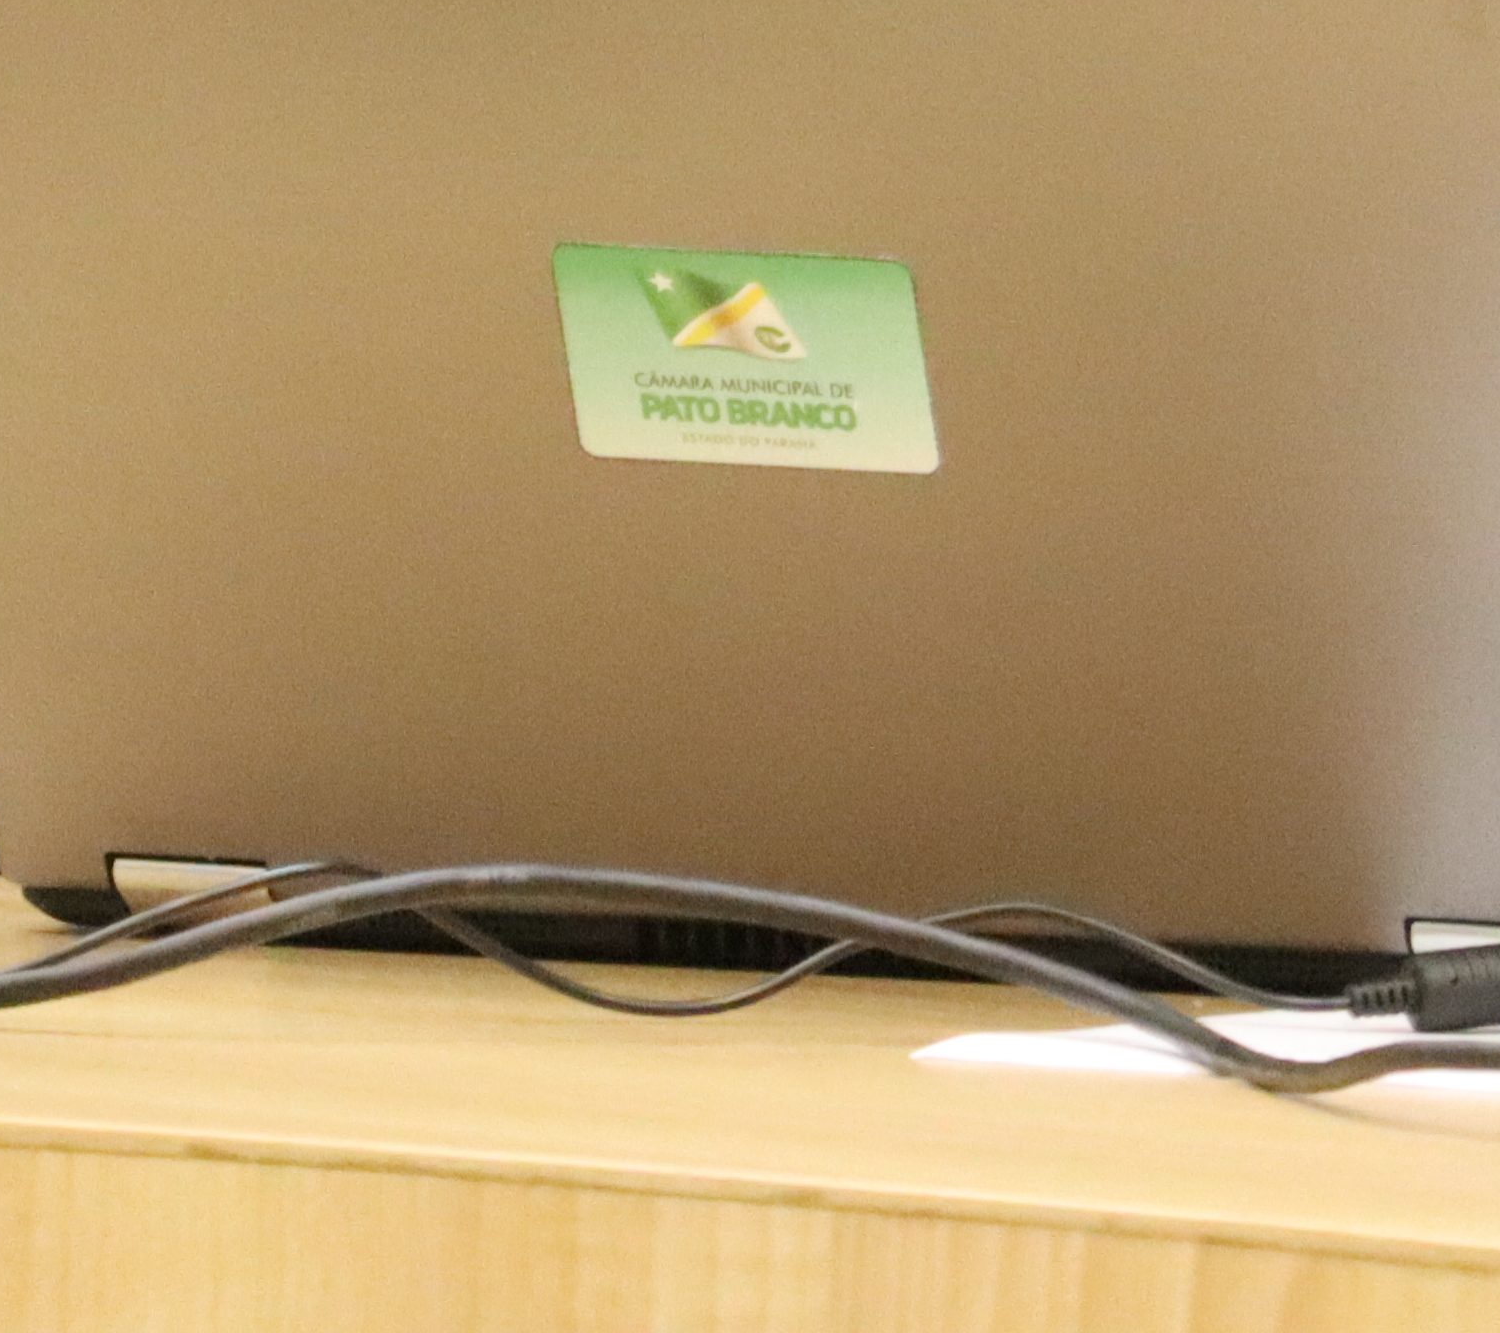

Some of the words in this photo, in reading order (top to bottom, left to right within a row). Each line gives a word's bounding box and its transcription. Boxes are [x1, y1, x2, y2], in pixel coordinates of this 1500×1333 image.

[634, 370, 713, 390] CÂMARA
[721, 379, 823, 397] MUNICIPAL
[830, 383, 853, 399] DE
[641, 393, 721, 424] PATO
[728, 399, 857, 432] BRANCO
